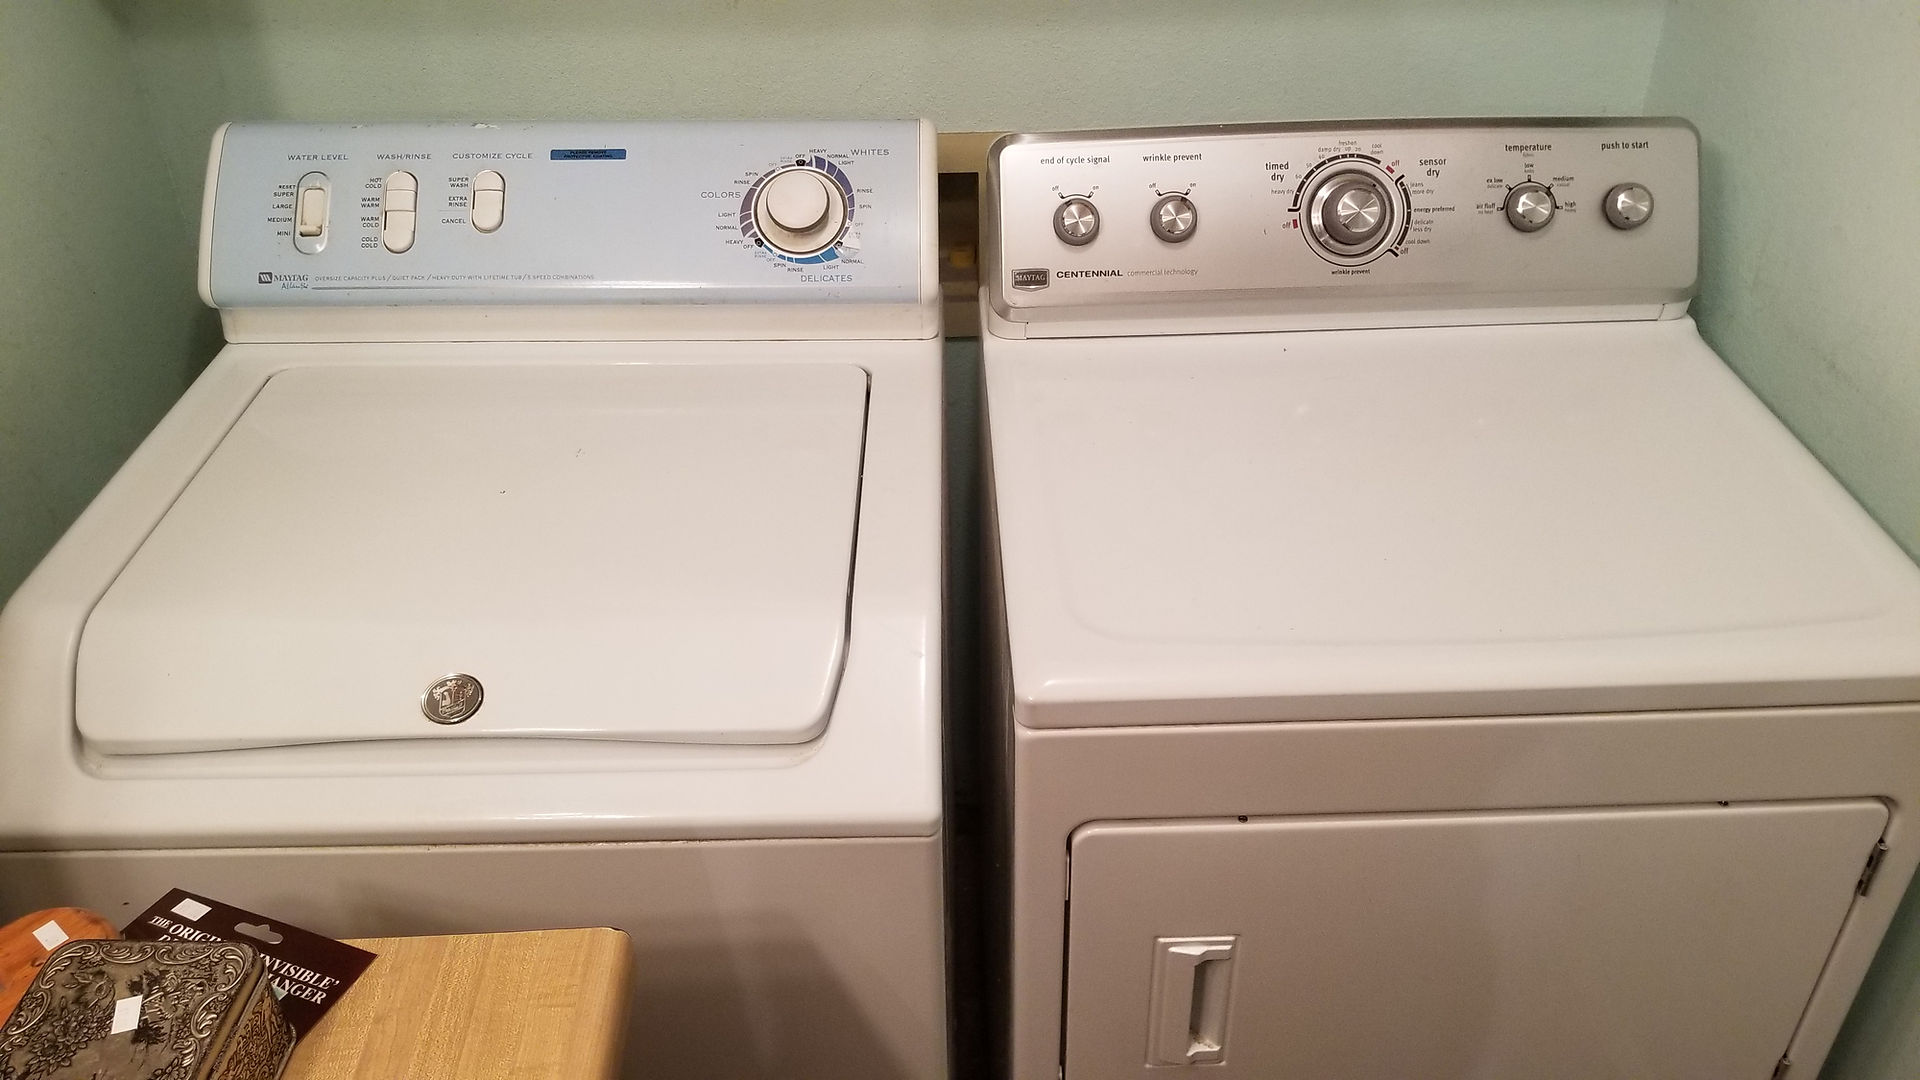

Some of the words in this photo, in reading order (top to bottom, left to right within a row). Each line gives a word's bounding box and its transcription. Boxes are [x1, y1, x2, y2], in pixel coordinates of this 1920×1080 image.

[1505, 144, 1552, 153] temperature
[1601, 141, 1620, 151] push
[1631, 141, 1649, 149] start
[850, 148, 889, 156] WHITES
[1040, 157, 1054, 165] end
[1056, 156, 1064, 165] of
[1065, 156, 1085, 166] cycle
[1087, 155, 1110, 166] signal
[1143, 153, 1171, 162] wrinkle
[1173, 153, 1202, 163] prevent
[1265, 162, 1290, 170] timed
[1271, 173, 1285, 183] dry
[1426, 168, 1440, 178] dry
[700, 191, 741, 199] COLORS
[800, 275, 853, 283] DELICATES
[1056, 270, 1123, 279] CENTENNIAL
[148, 915, 173, 929] THE
[260, 953, 340, 990] NVISIBLE'
[268, 973, 327, 1005] ANGER
